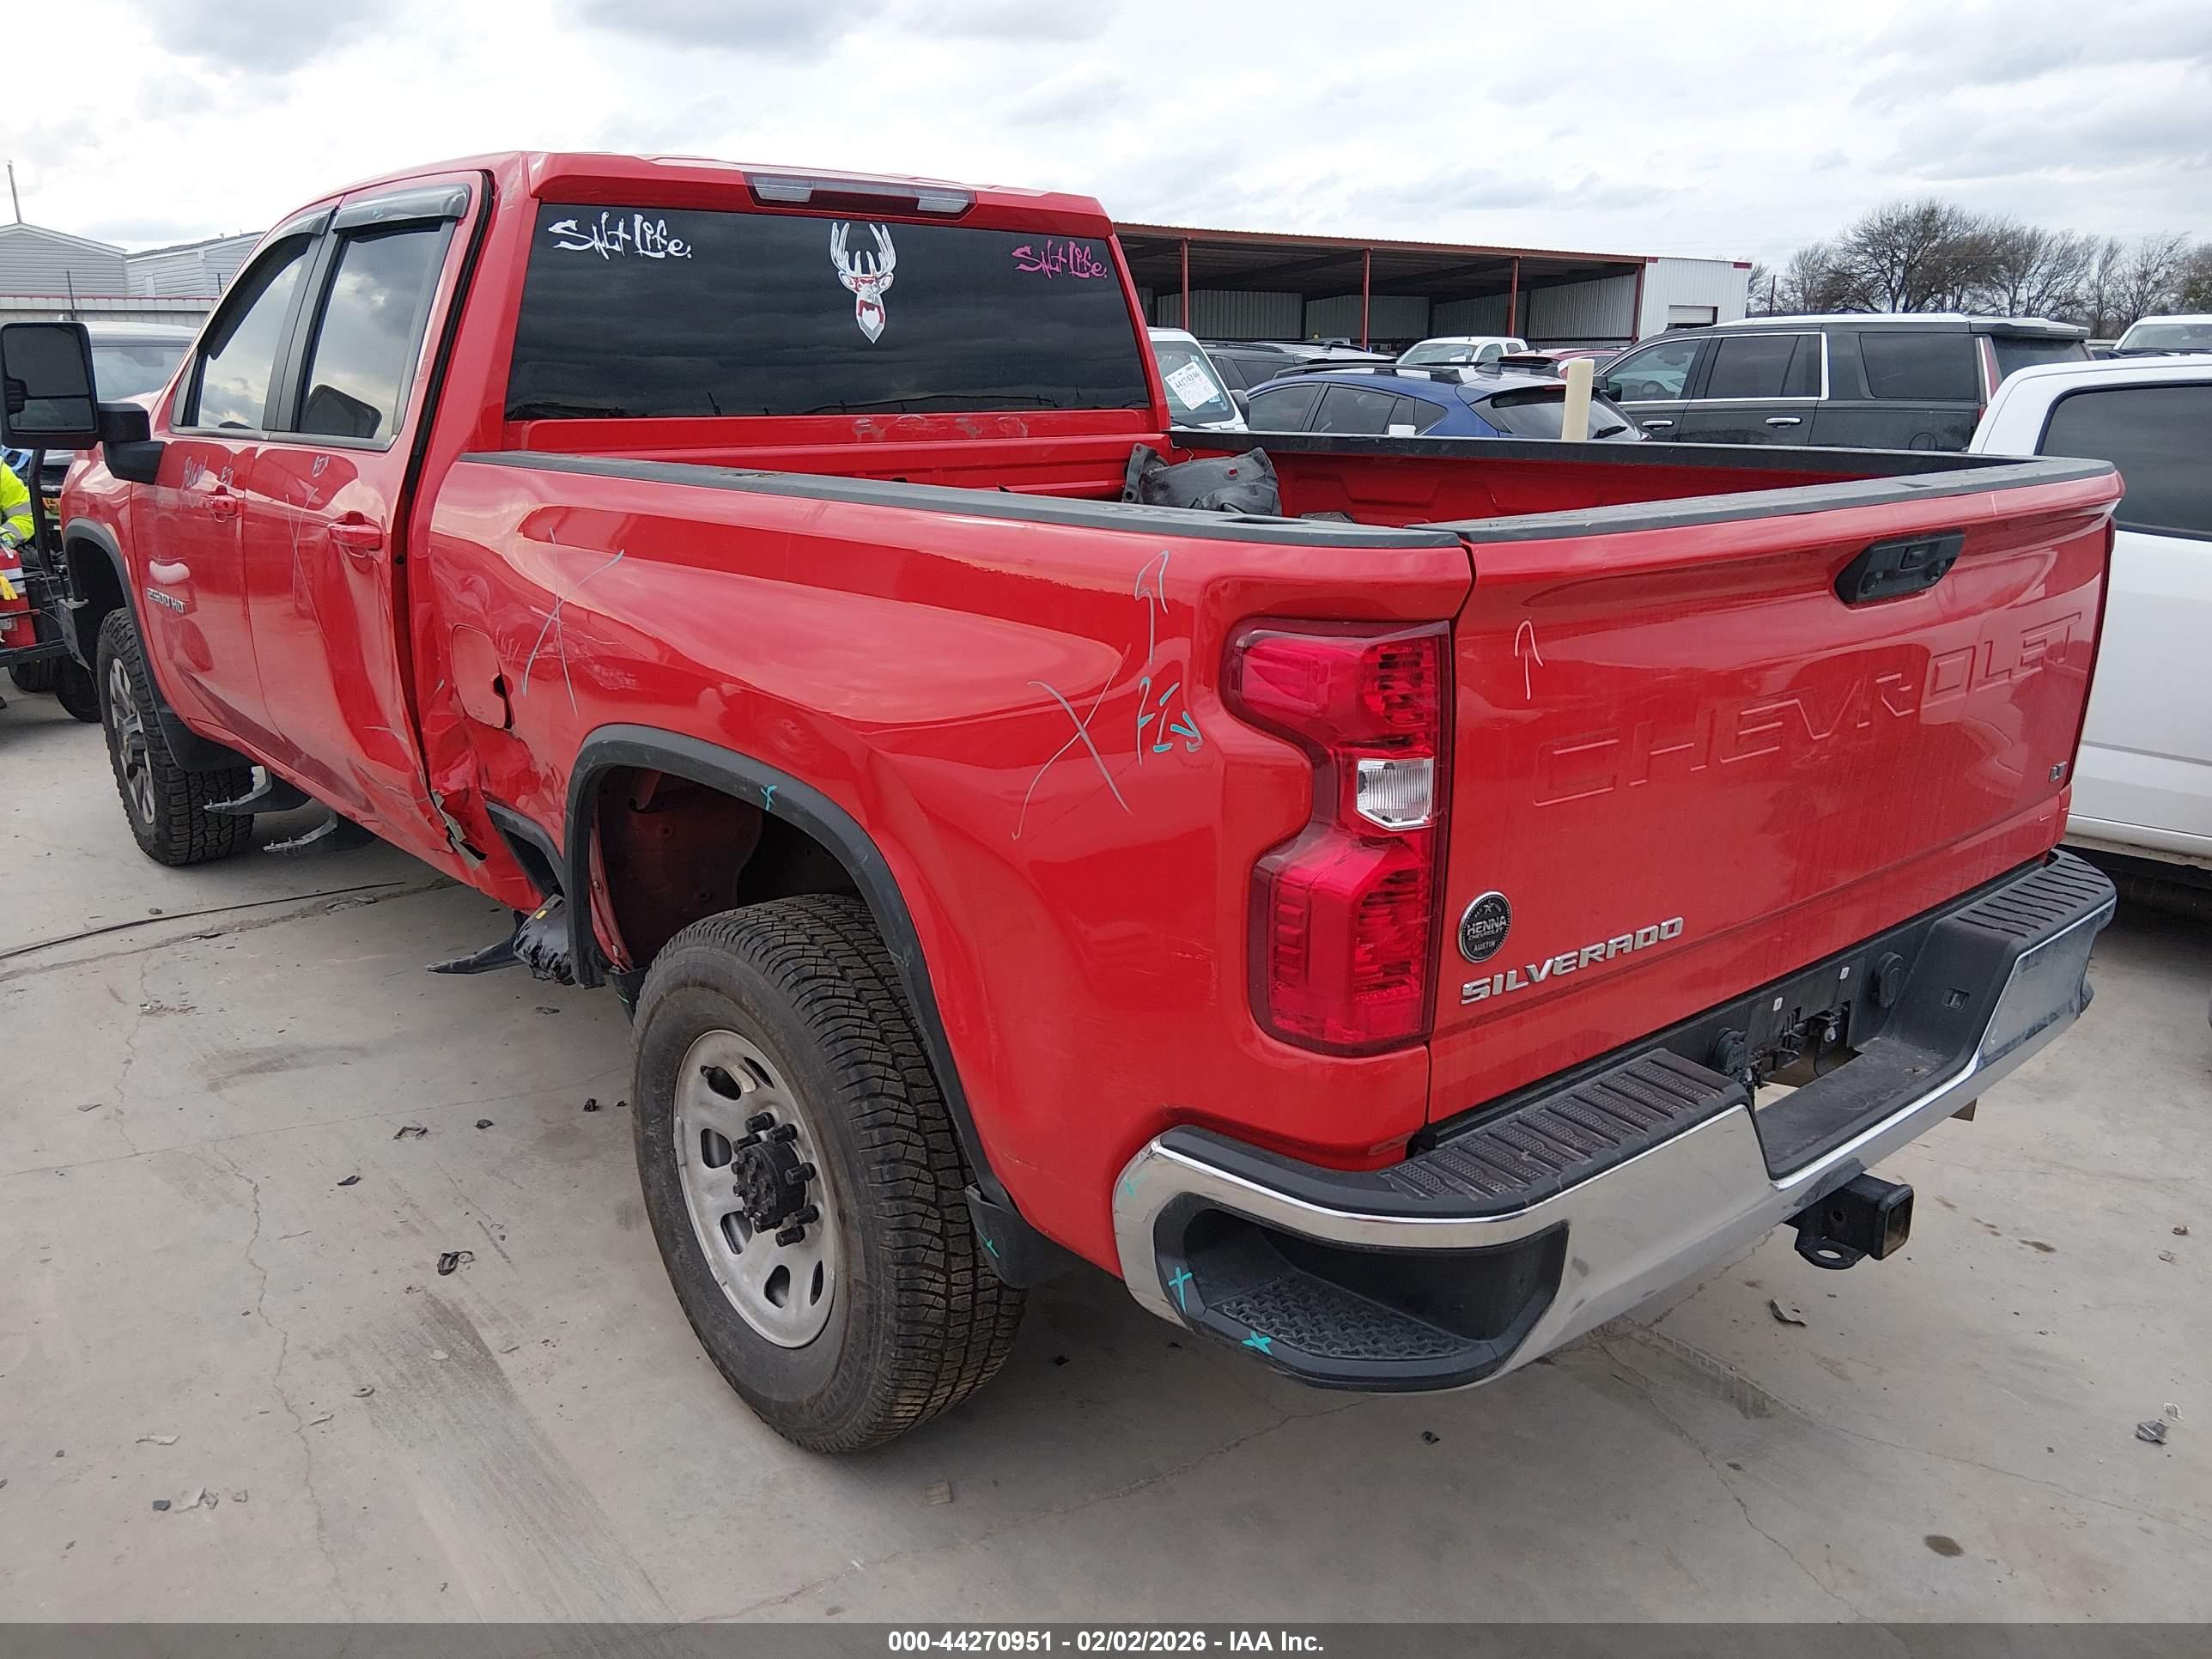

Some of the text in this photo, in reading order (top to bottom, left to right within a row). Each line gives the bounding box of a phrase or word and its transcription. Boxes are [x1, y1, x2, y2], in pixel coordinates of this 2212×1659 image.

[1532, 611, 2082, 809] CHEVROLET
[1467, 915, 1507, 936] HENNA
[1473, 940, 1497, 953] AUSTIN
[1460, 916, 1684, 1005] SILVERADO
